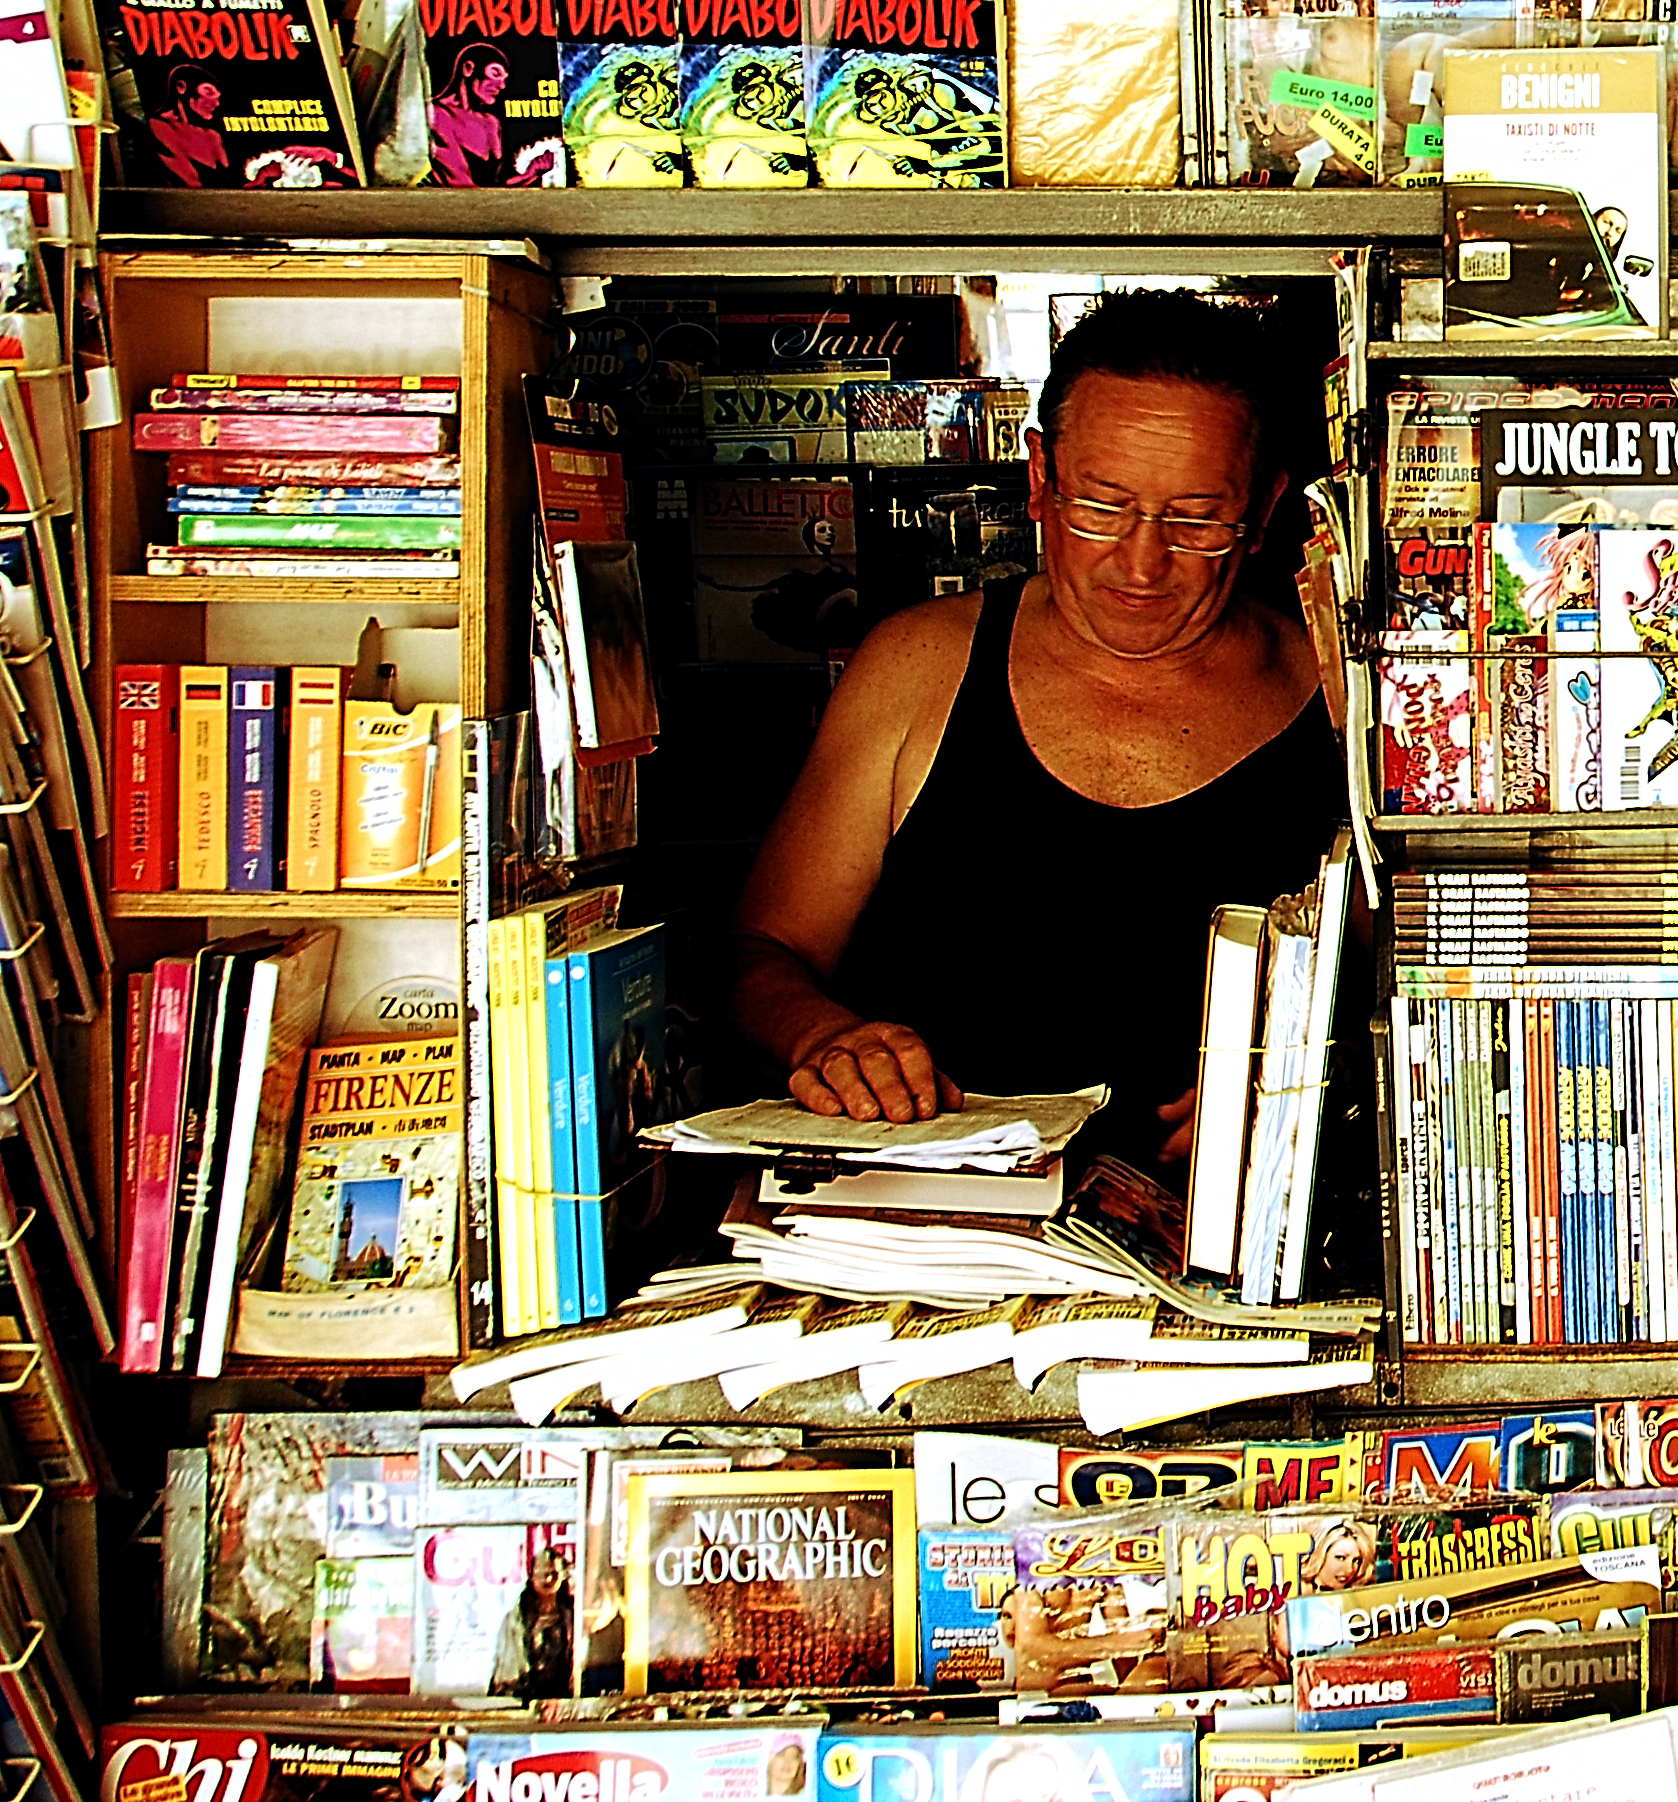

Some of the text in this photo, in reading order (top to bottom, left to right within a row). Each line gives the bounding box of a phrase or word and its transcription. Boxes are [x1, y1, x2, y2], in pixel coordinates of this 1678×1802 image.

[119, 8, 302, 61] DIABOLIK
[252, 98, 324, 116] COMPLICE
[1288, 81, 1374, 111] Euro 14,00
[1500, 73, 1601, 110] BENIGNI
[224, 114, 330, 134] INVOLONTARIO
[1319, 107, 1373, 154] DURATA
[1505, 121, 1597, 137] TAXISTI DI NOTTE
[712, 383, 848, 426] SUDOK
[1495, 421, 1643, 476] JUNGLE
[258, 461, 280, 479] La
[328, 460, 344, 478] di
[701, 485, 855, 520] BALLETTO
[1388, 507, 1470, 518] Alfred Molina
[132, 789, 149, 852] INGLESE
[197, 790, 211, 851] TEDESCO
[308, 788, 322, 849] SPAGNOLO
[379, 996, 458, 1020] Zoom
[403, 989, 434, 999] carta
[406, 1022, 432, 1033] map
[319, 1044, 453, 1069] PIANTA MAP PLAN
[310, 1069, 455, 1115] FIRENZE
[552, 1077, 568, 1131] Verdure
[577, 1073, 593, 1126] Verdure
[308, 1120, 374, 1140] STADTPLAN
[320, 1306, 388, 1319] FLORENCE
[692, 1505, 856, 1548] NATIONAL
[654, 1538, 888, 1588] GEOGRAPHIC
[1181, 1532, 1313, 1619] HOT
[1591, 1552, 1635, 1565] edizione
[1595, 1558, 1648, 1573] TOSCANA
[1193, 1581, 1292, 1627] baby
[1318, 1593, 1452, 1648] dentro
[1517, 1652, 1638, 1691] domus
[1310, 1680, 1408, 1709] domus
[105, 1736, 259, 1802] Chi
[475, 1757, 668, 1802] Novella
